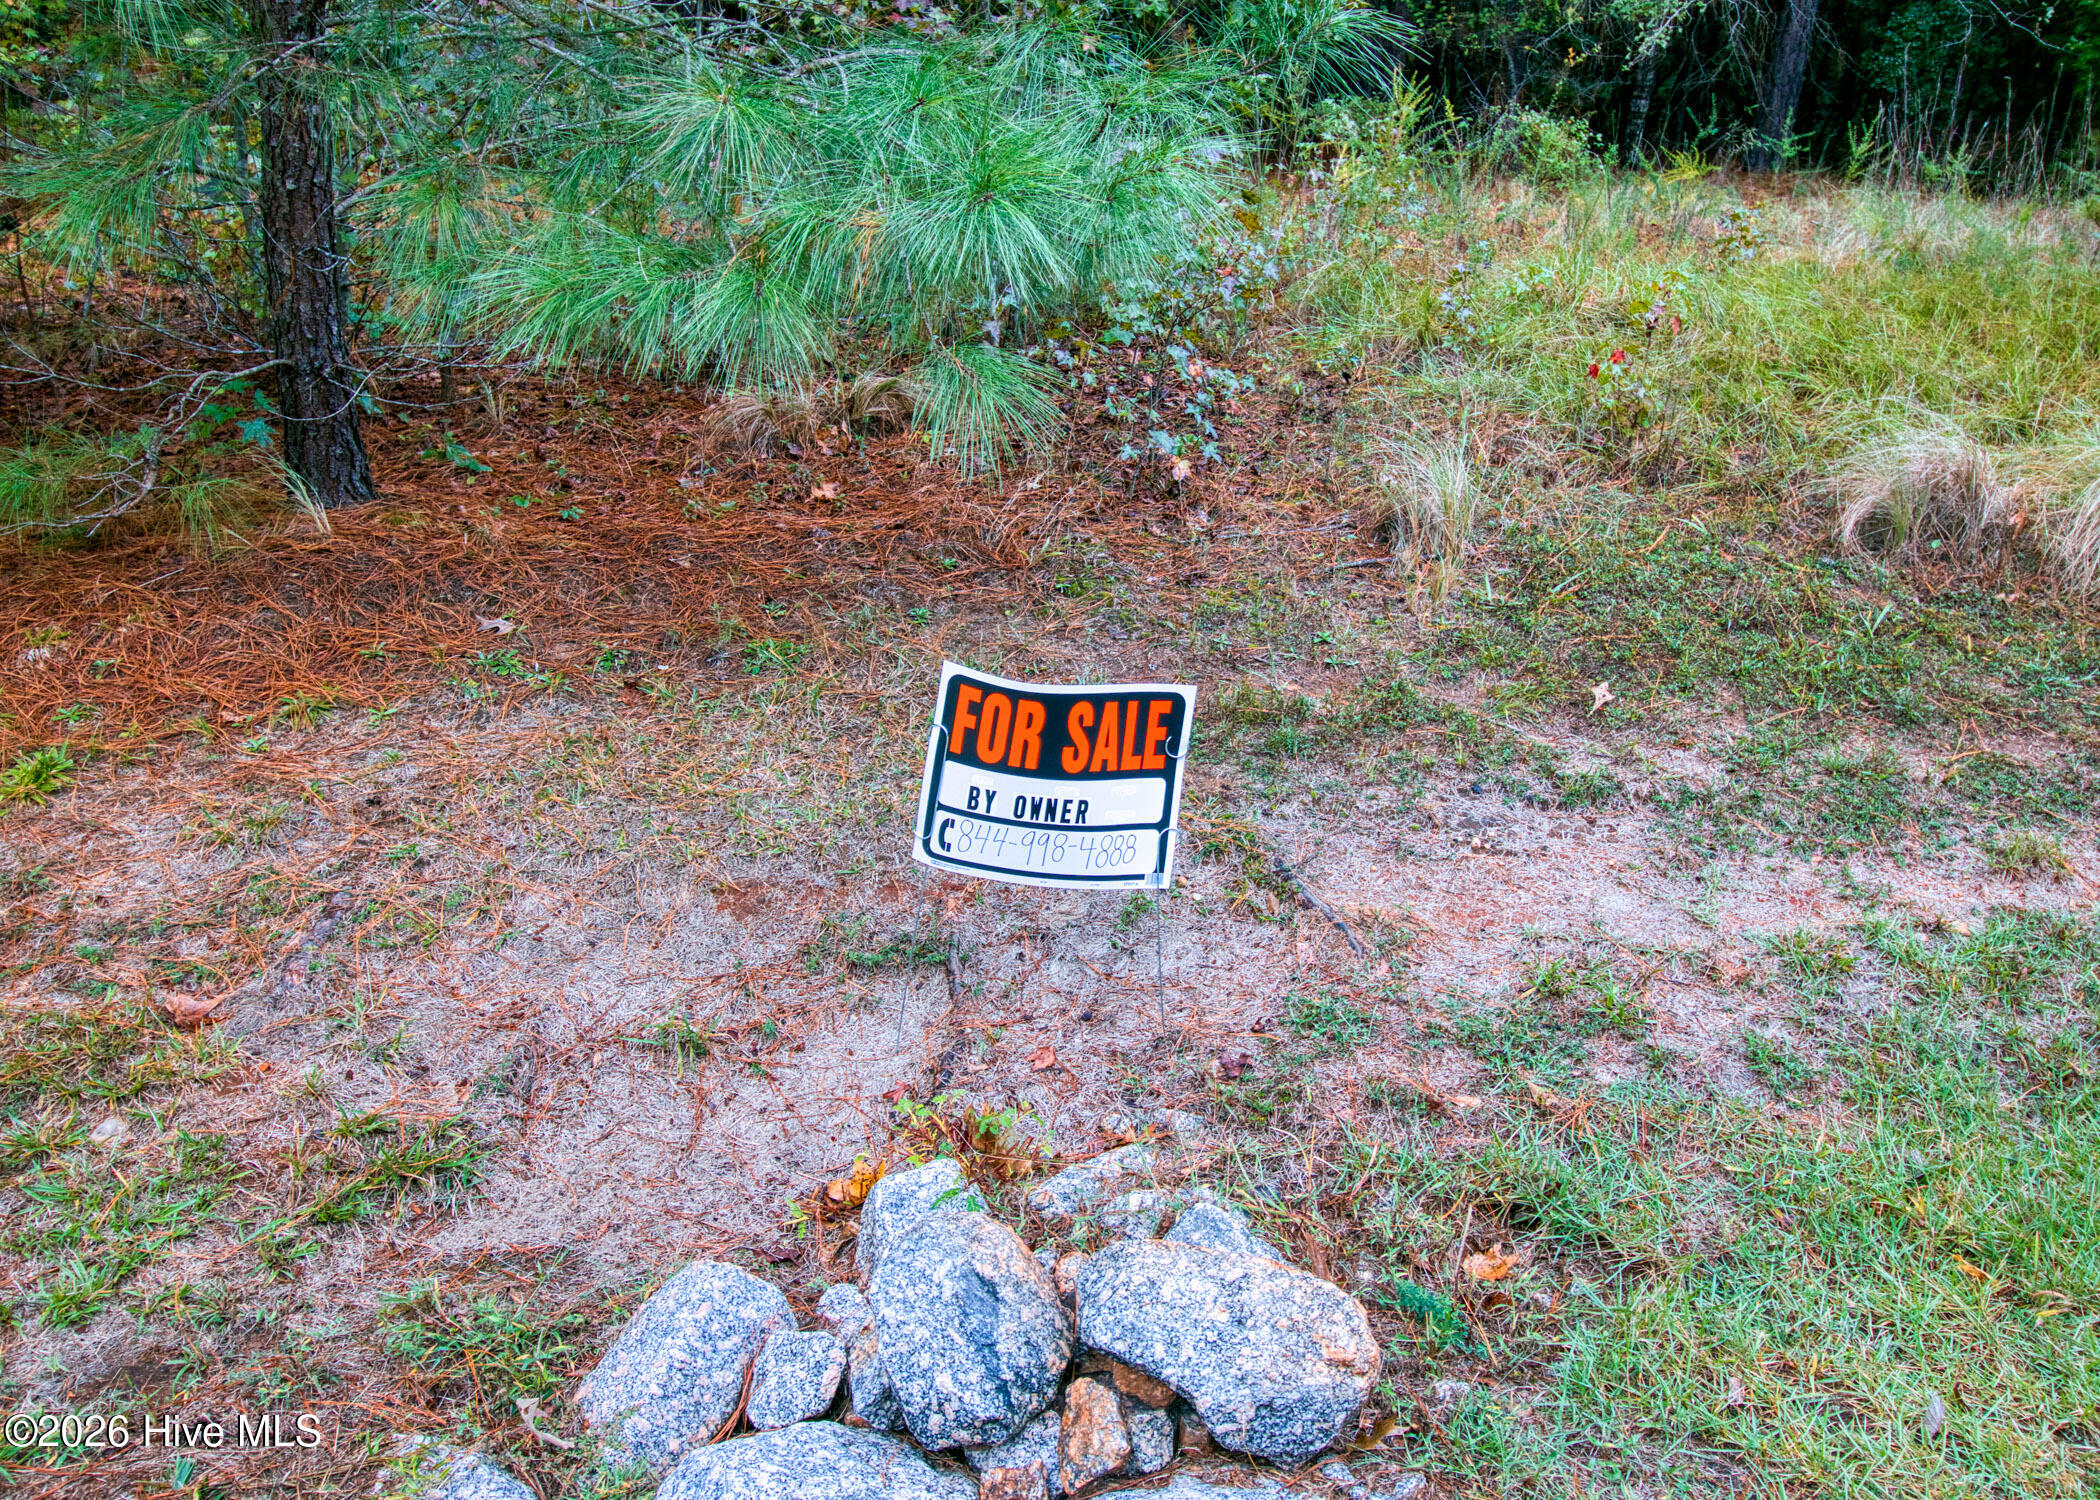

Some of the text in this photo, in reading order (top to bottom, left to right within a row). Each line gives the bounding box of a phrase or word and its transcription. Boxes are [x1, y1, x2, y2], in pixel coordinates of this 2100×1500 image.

[949, 683, 1174, 774] FOR SALE
[966, 785, 1090, 824] BY OWNER
[957, 819, 1137, 869] 844-998-4888
